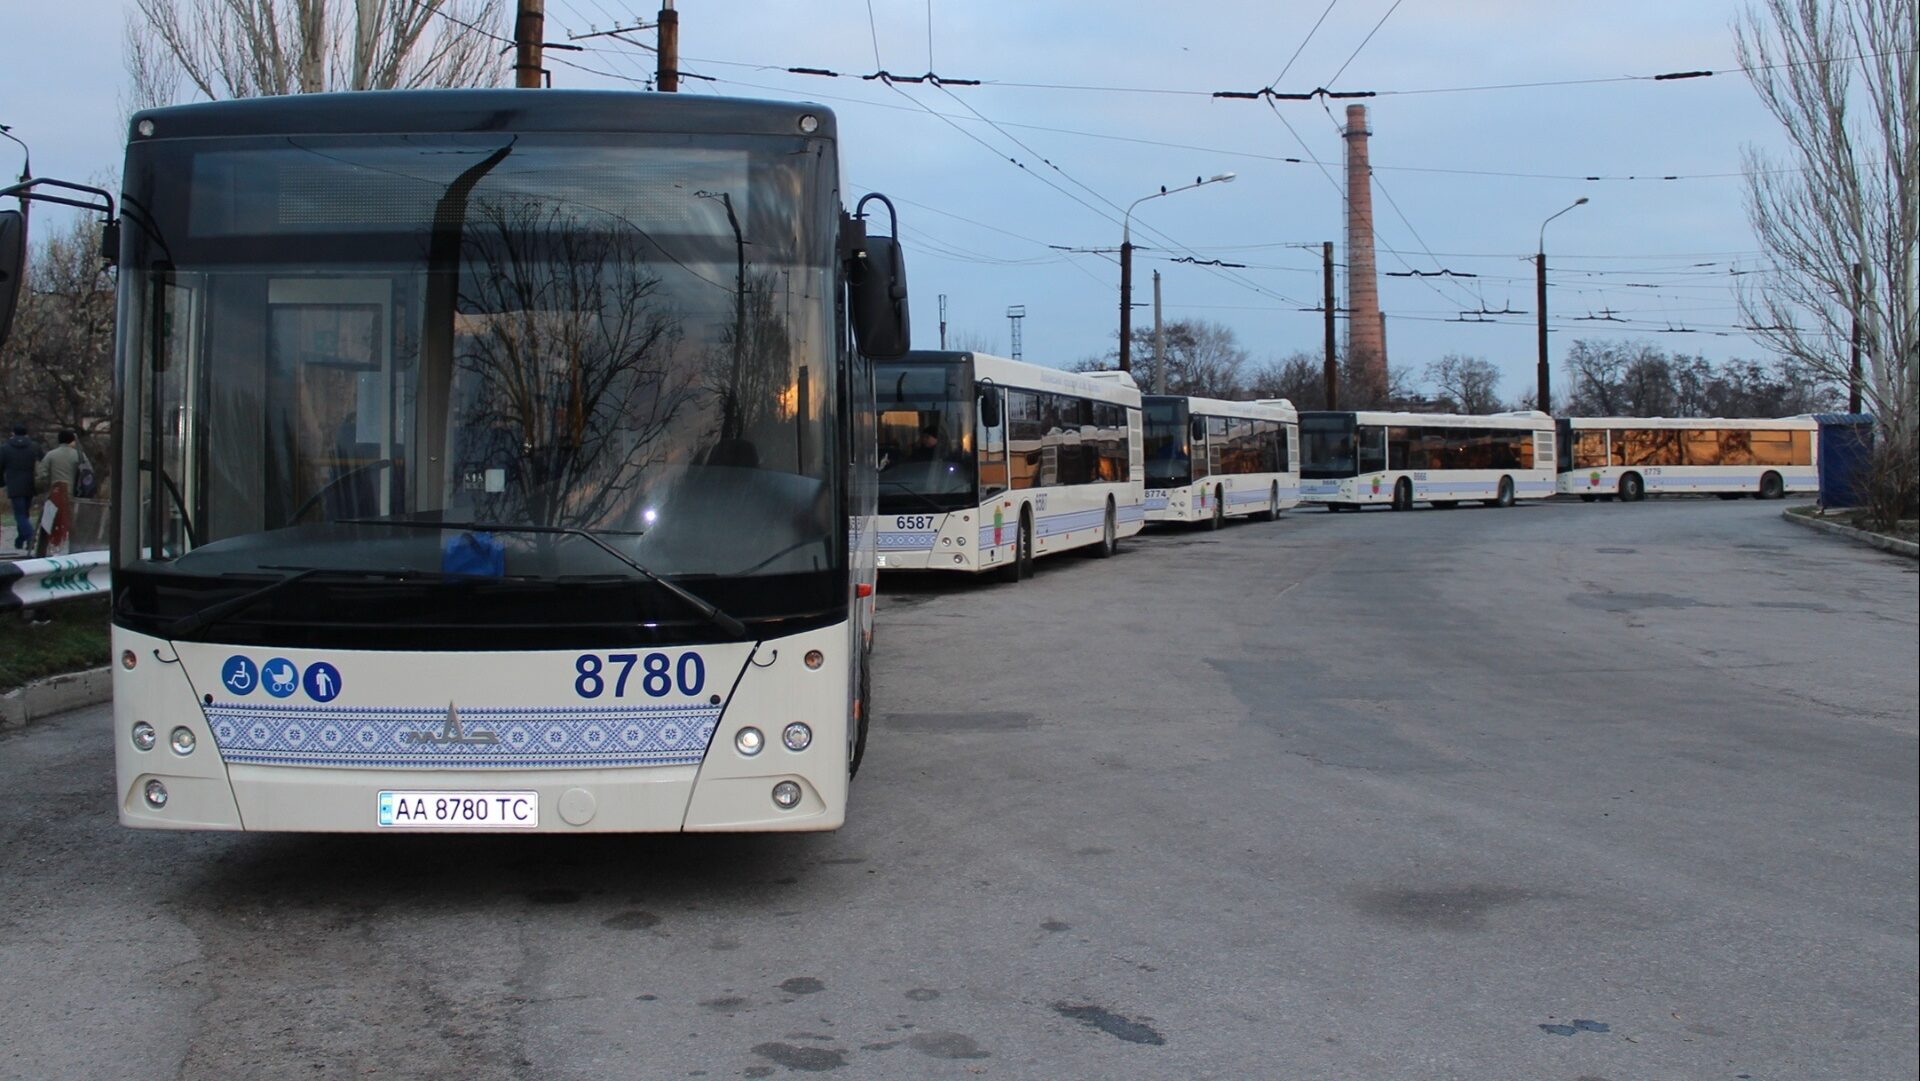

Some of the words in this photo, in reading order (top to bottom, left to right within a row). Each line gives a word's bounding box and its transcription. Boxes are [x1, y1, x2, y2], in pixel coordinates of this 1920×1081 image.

[896, 516, 934, 529] 6587
[575, 653, 705, 698] 8780
[396, 798, 428, 820] AA
[435, 798, 488, 821] 8780
[496, 798, 528, 820] TC
